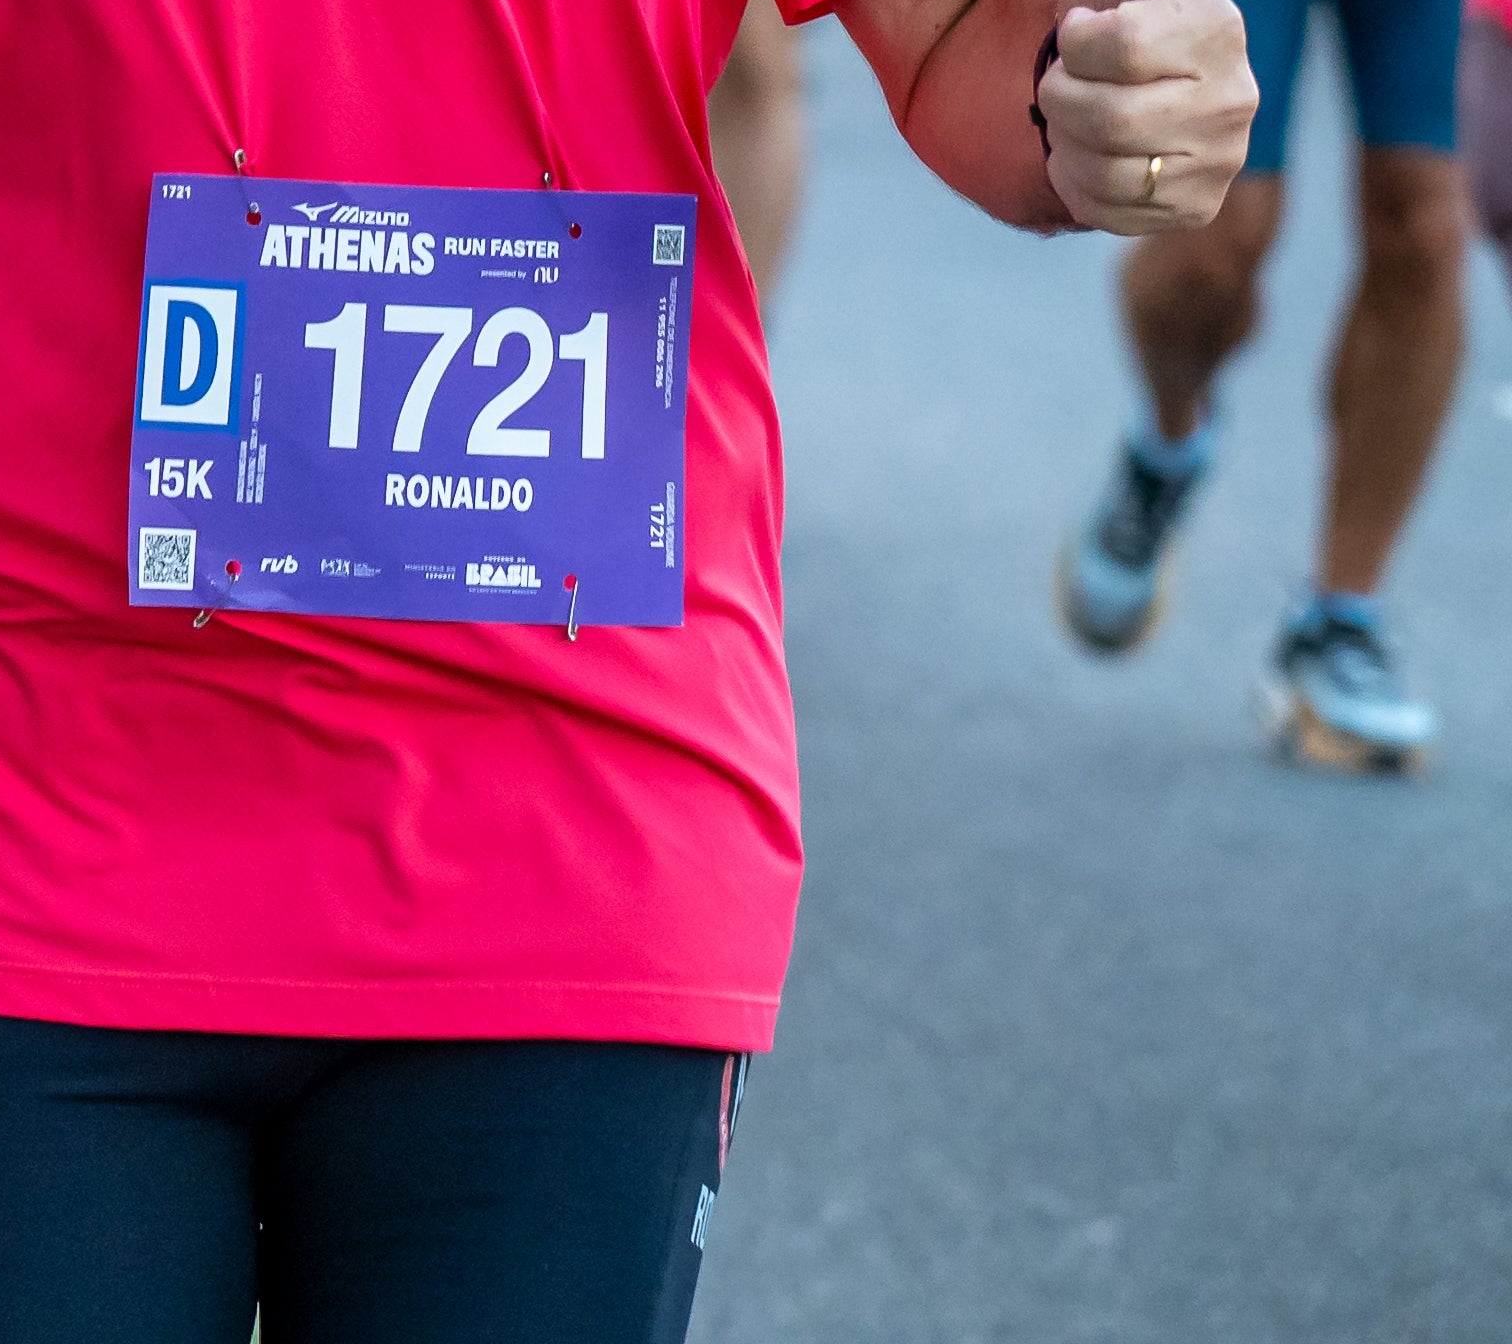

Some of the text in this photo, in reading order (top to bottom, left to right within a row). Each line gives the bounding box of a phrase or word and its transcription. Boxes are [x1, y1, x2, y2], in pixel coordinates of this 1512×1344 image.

[162, 184, 192, 200] 1721
[260, 223, 559, 275] ATHENAS RUN FASTER
[160, 299, 219, 407] D
[304, 302, 609, 460] 1721
[145, 458, 212, 499] 15K
[385, 474, 534, 511] RONALDO
[649, 502, 665, 548] 1721
[260, 555, 299, 575] rvb
[465, 562, 542, 588] BRASIL
